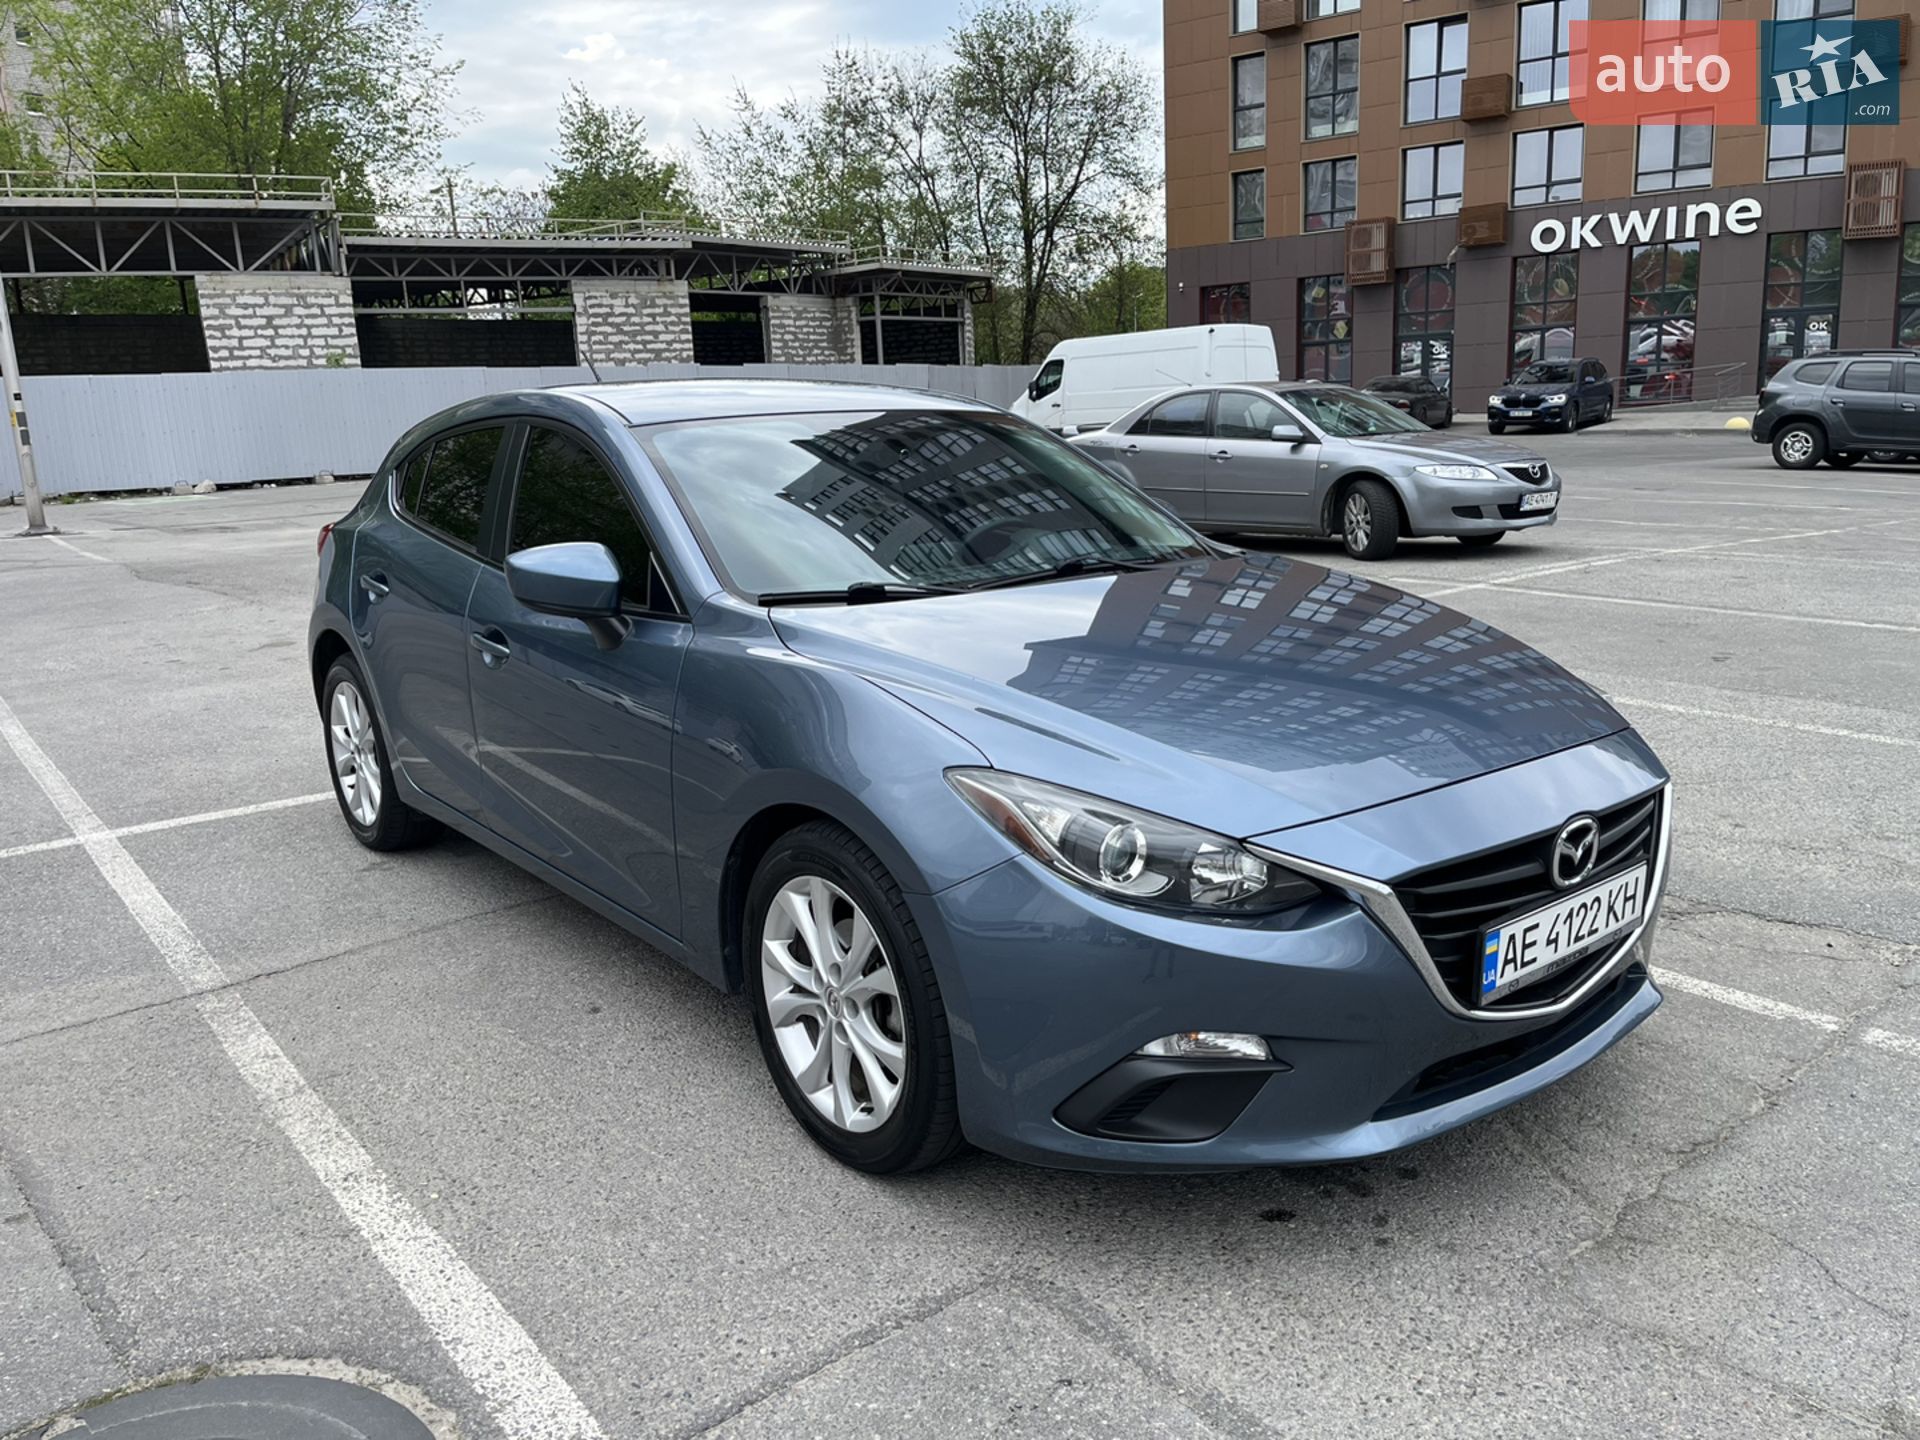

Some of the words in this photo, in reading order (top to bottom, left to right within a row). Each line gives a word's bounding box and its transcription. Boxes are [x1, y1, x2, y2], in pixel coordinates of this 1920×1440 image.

[1809, 321, 1828, 330] OK
[1500, 922, 1540, 979] AE
[1546, 896, 1602, 954] 4122
[1605, 876, 1639, 928] KH
[1483, 968, 1496, 985] UA
